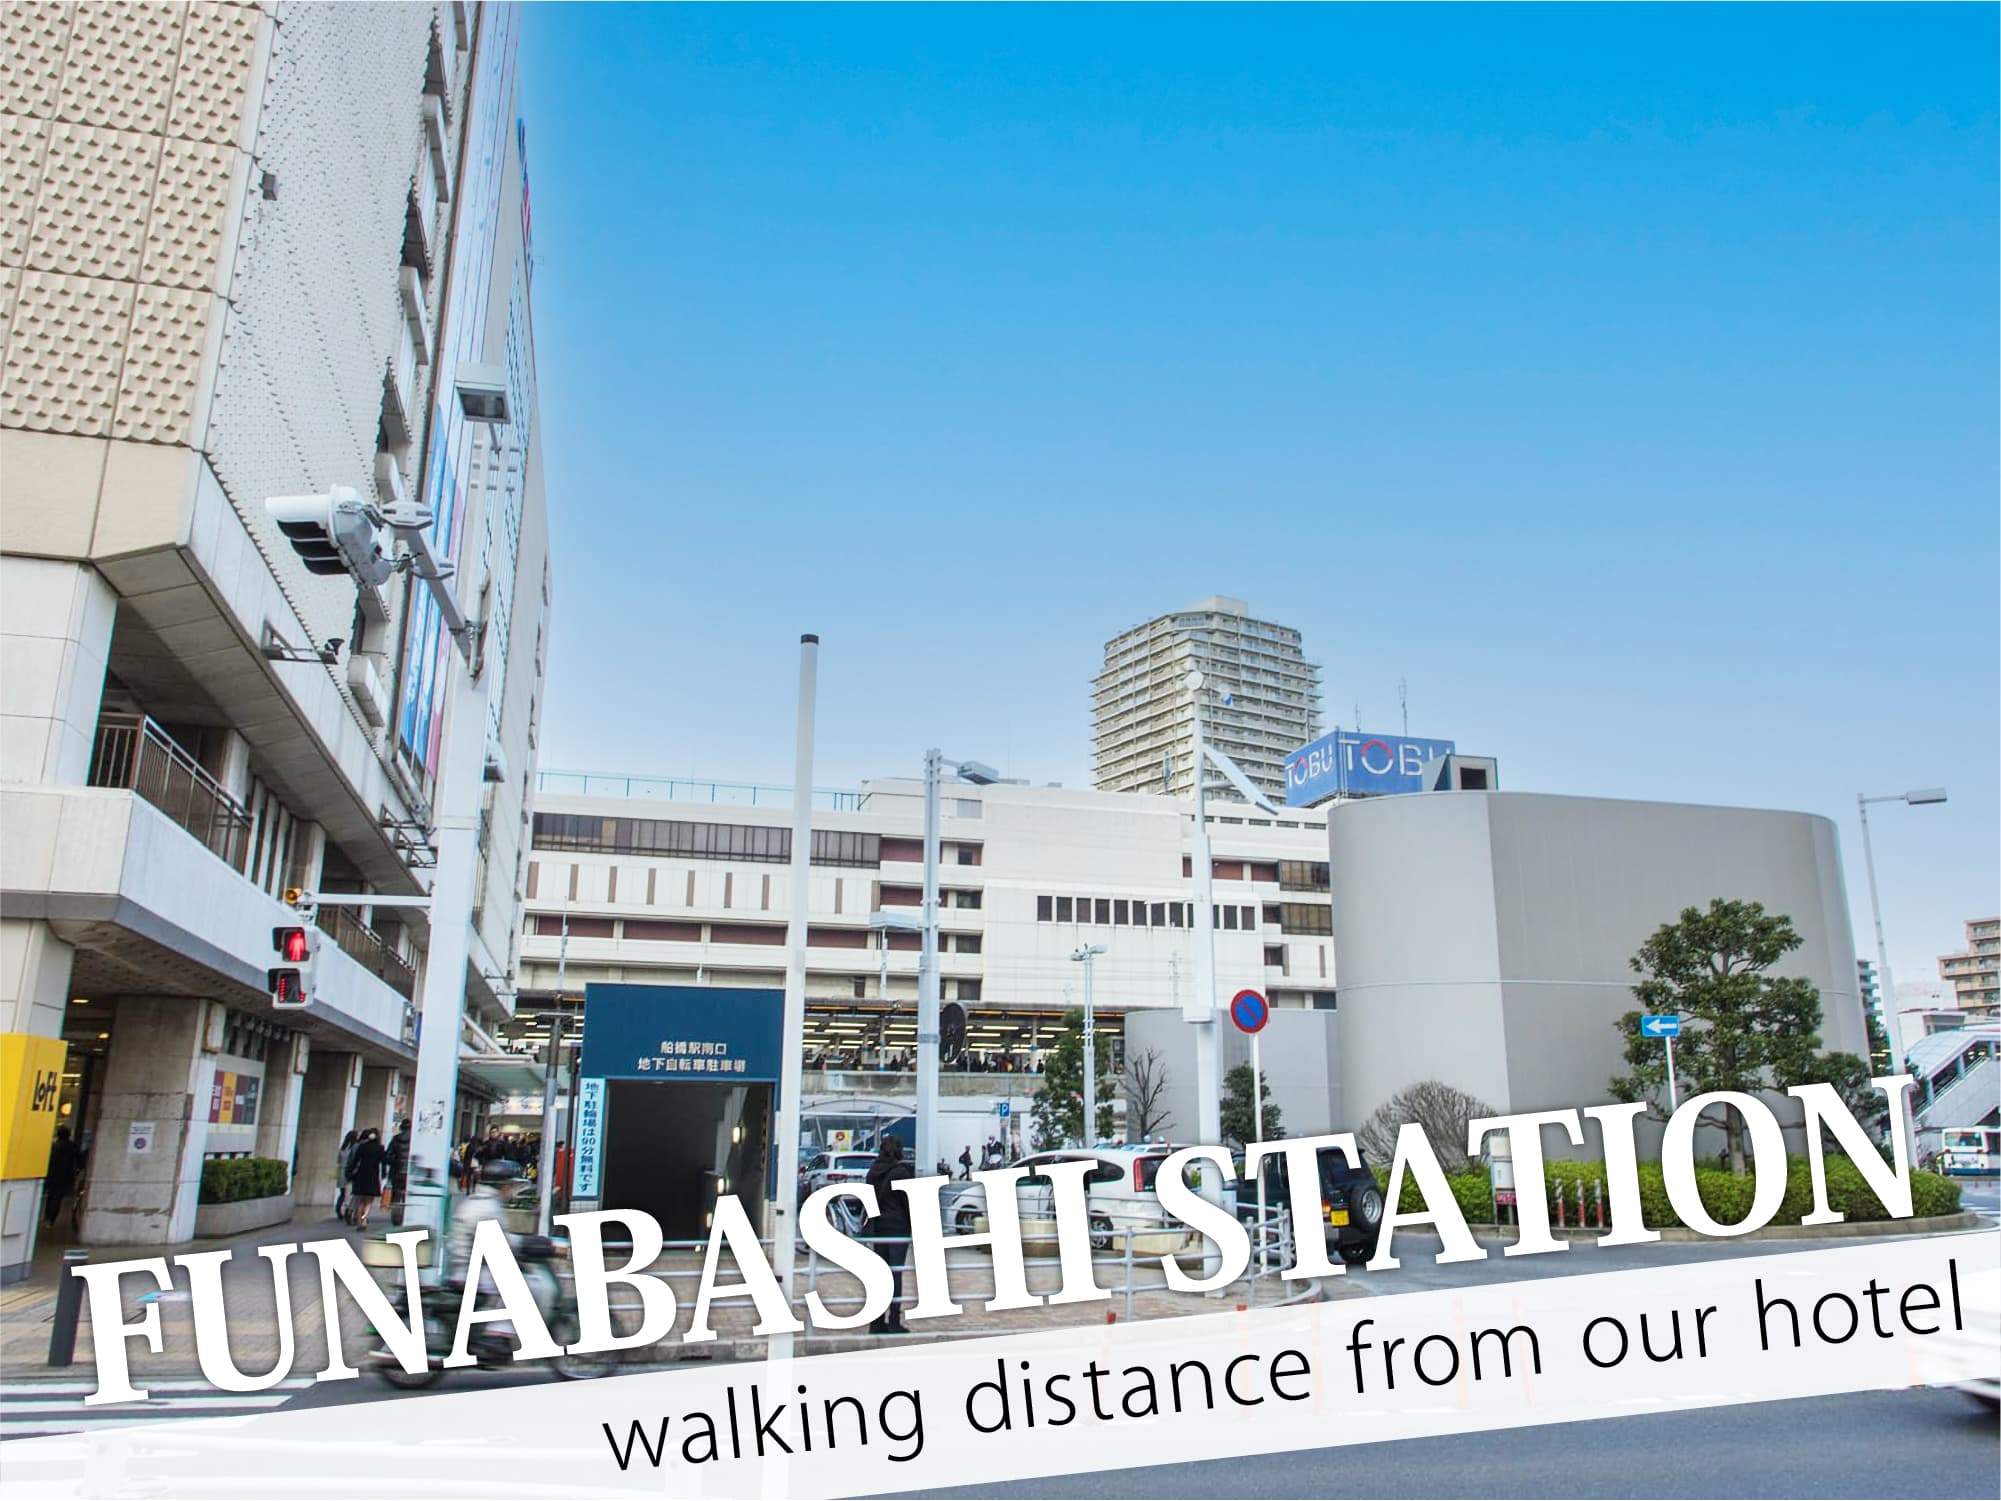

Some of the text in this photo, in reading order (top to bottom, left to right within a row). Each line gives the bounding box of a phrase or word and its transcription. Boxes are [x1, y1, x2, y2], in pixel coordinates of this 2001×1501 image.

[1286, 743, 1333, 788] TOBU
[660, 1040, 727, 1056] 船橋駅南口
[638, 1057, 746, 1073] 地下自転車駐車場
